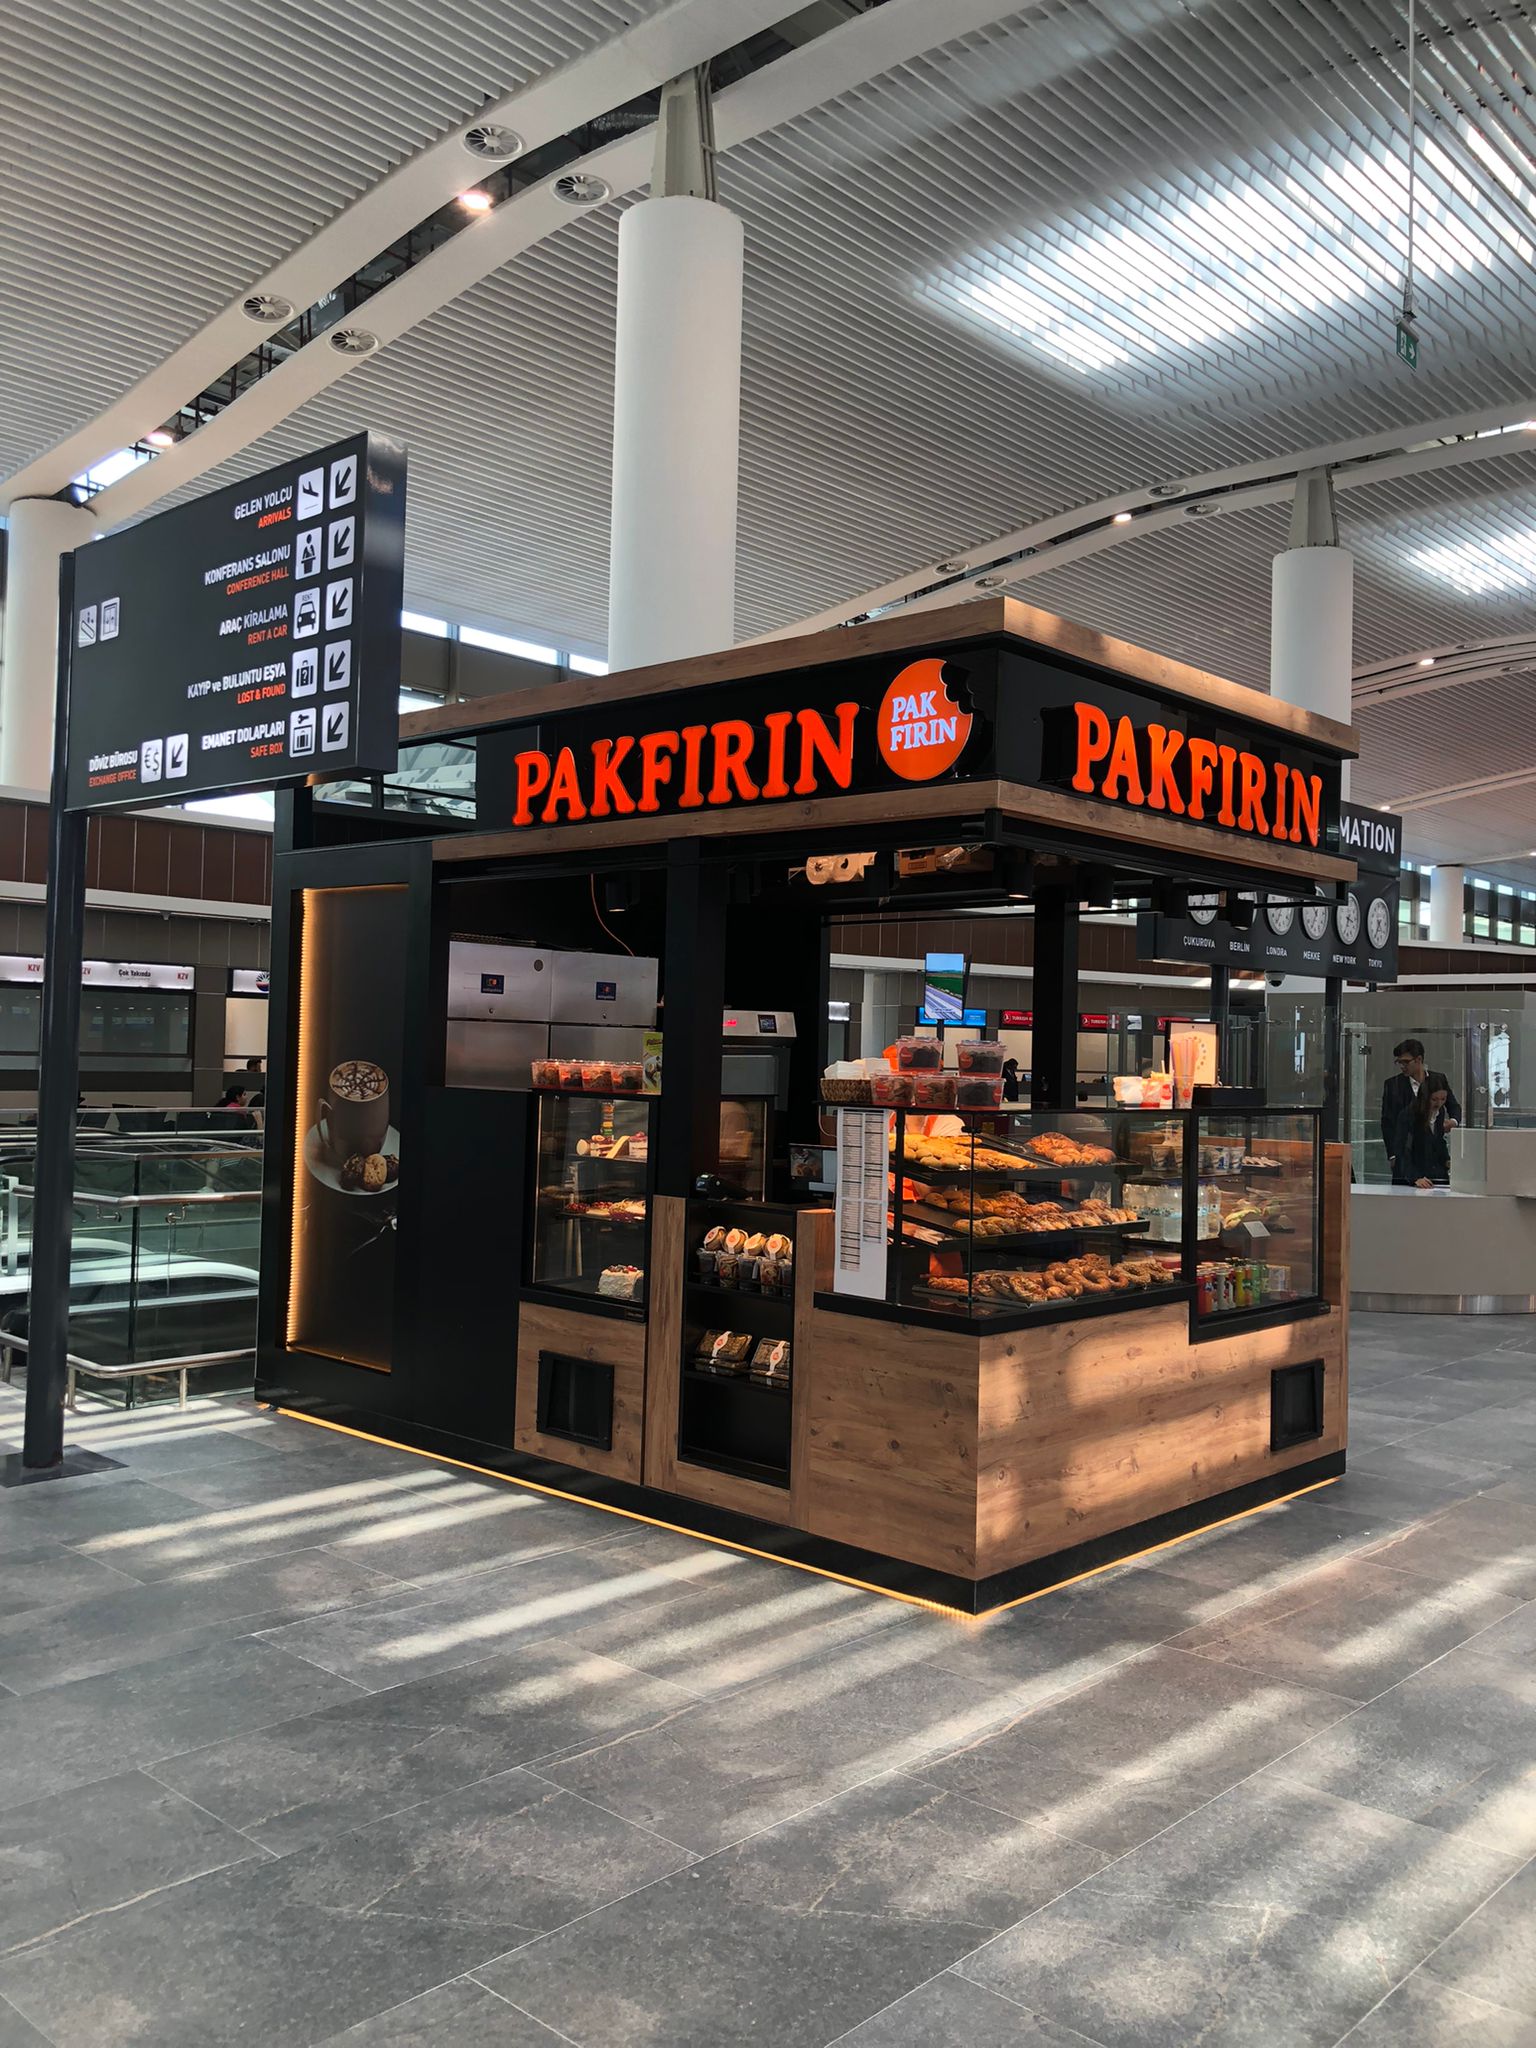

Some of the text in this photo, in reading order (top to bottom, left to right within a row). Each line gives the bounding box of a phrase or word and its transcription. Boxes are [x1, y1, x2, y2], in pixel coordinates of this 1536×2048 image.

[234, 486, 293, 520] GELEN YOLCU
[258, 507, 291, 528] ARRIVALS
[204, 544, 291, 586] KONFERANS SALONU
[226, 566, 289, 595] CONFERENCE HALL
[219, 604, 288, 636] ARAÇ KİRALAMA
[247, 624, 288, 645] RENT A CAR
[187, 662, 286, 699] KAYIP ve BULUNTU EŞYA
[237, 683, 286, 705] LOST & FOUND
[890, 690, 937, 723] PAK
[202, 720, 285, 750] EMANET DOLAPLARI
[889, 716, 958, 753] FIRIN
[250, 741, 284, 758] SAFE BOX
[89, 750, 138, 772] DÖVİZ BÜROSU
[512, 701, 860, 827] PAKFIRIN
[89, 769, 137, 787] EXCHANGE OFFICE
[1072, 701, 1323, 848] PAKFIRIN
[1183, 935, 1216, 949] ÇUKUROVA
[1266, 946, 1288, 957] LONDRA
[1303, 950, 1321, 961] MEKKE
[1332, 954, 1356, 965] NEW YORK
[1368, 958, 1383, 968] TOKYO
[27, 963, 41, 972] KZV
[177, 972, 189, 980] KZV
